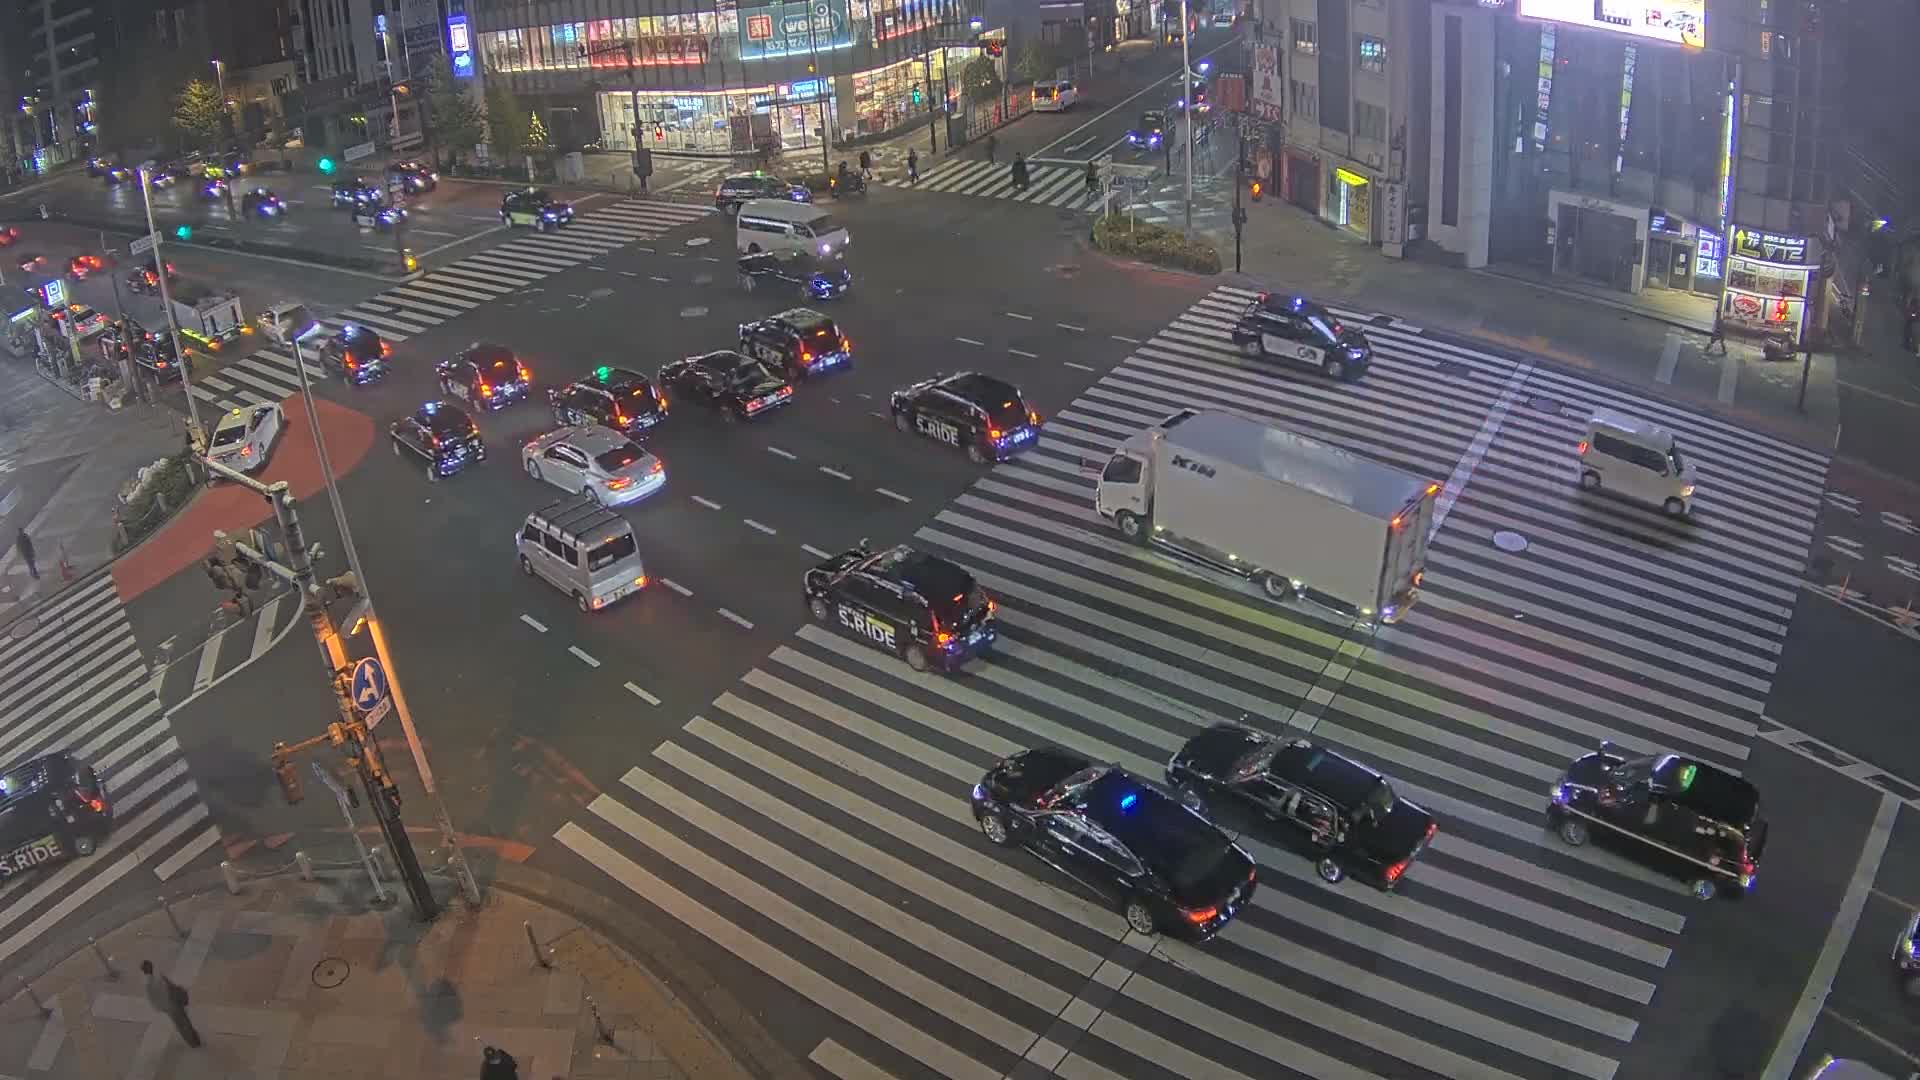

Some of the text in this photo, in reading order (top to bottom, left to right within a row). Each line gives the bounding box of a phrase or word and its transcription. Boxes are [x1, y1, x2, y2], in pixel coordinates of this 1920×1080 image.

[916, 417, 959, 447] S.RIDE
[838, 608, 897, 649] S.RIDE
[0, 840, 61, 876] S.RIDE
